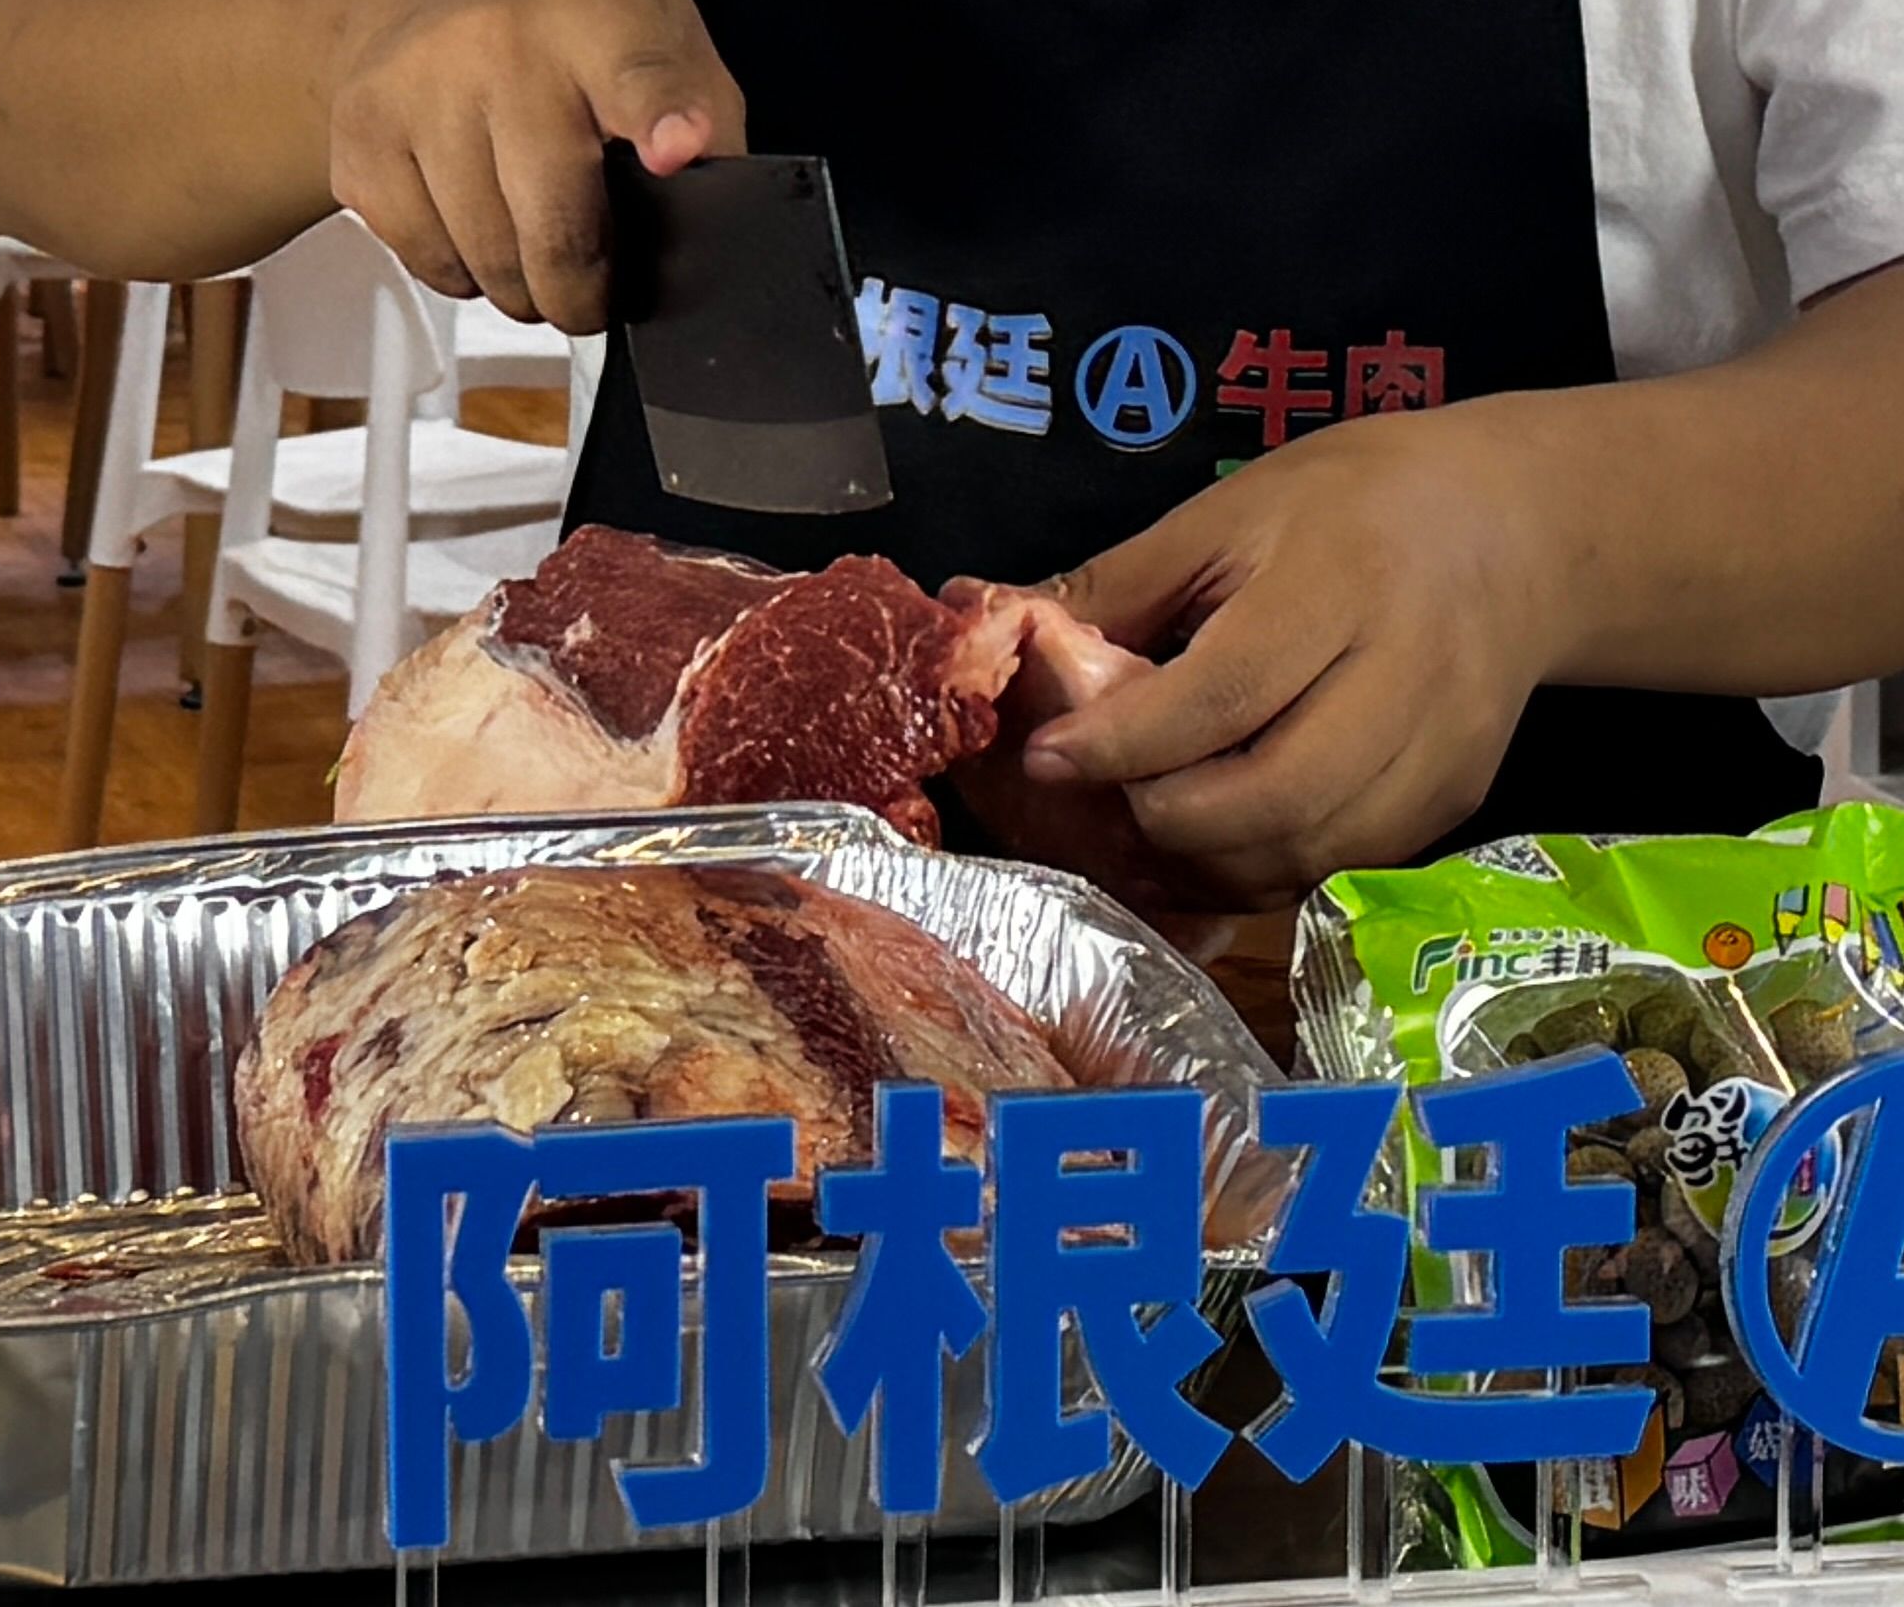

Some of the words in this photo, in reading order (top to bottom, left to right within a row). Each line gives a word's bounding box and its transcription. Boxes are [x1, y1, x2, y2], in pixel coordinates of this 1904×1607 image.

[1216, 329, 1445, 447] 牛肉
[385, 1046, 1658, 1550] 阿根廷
